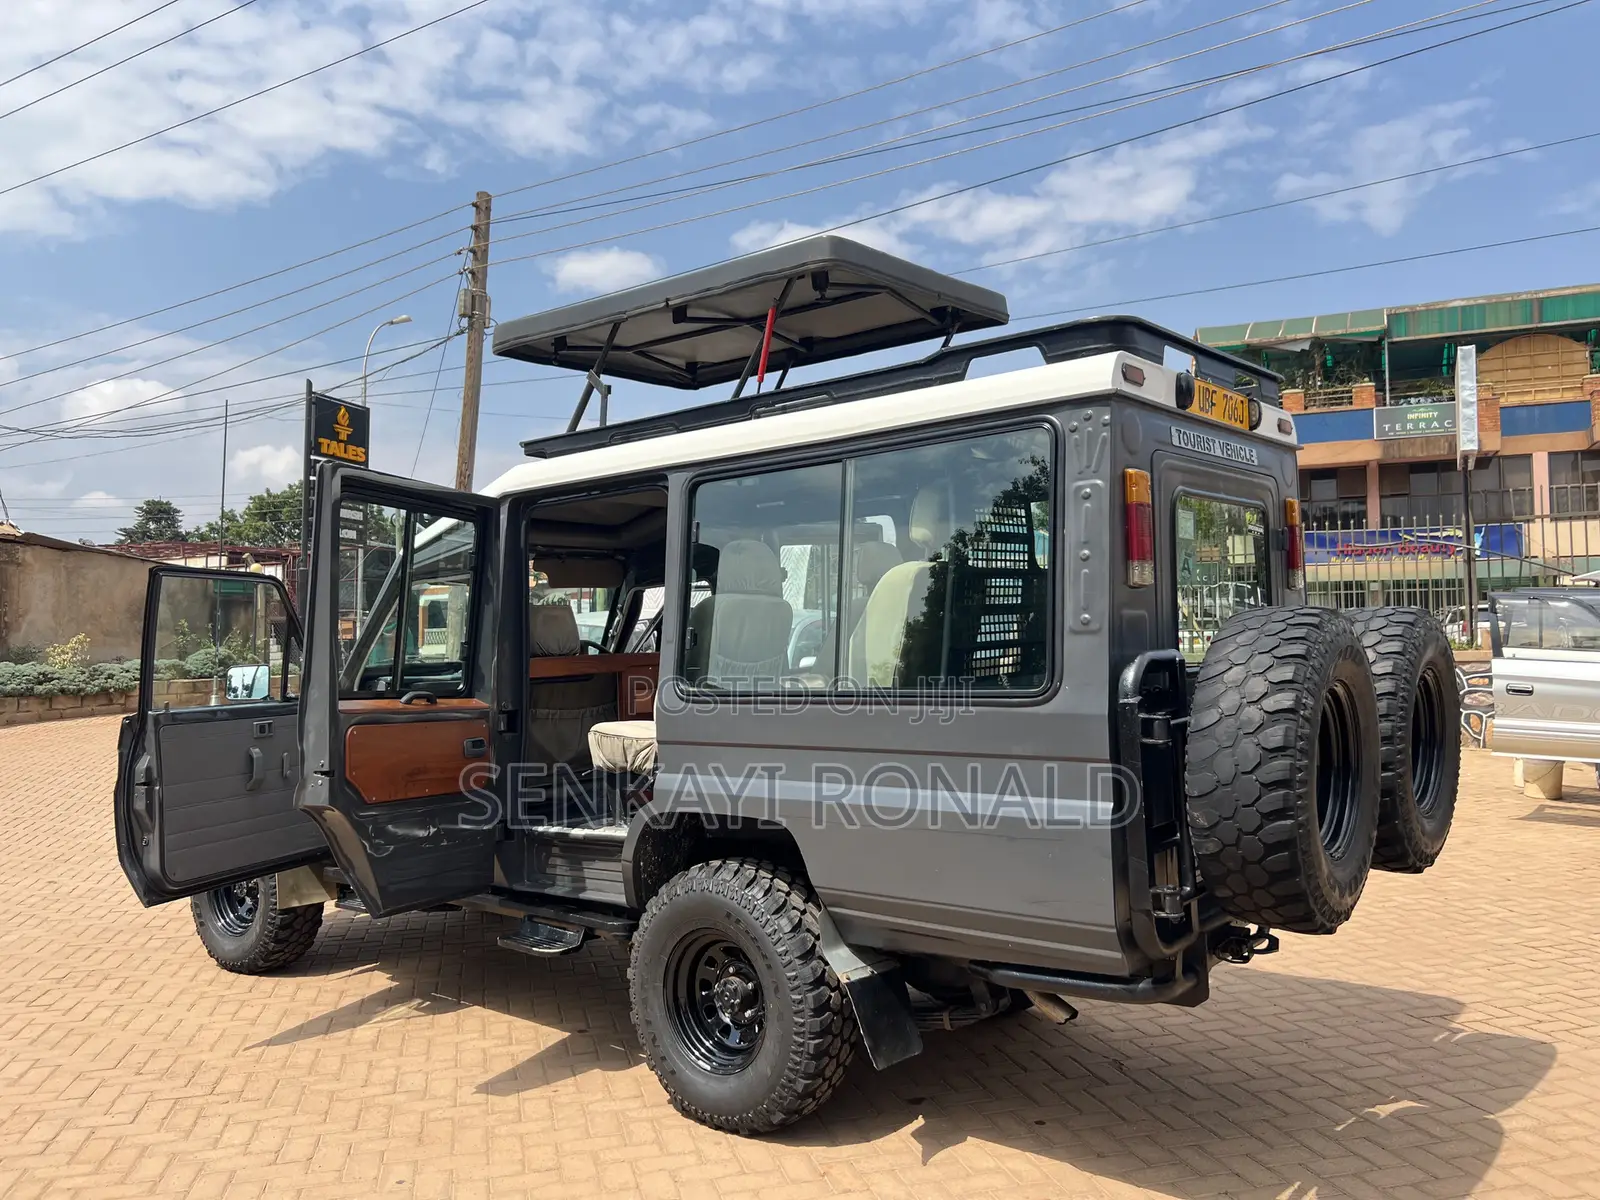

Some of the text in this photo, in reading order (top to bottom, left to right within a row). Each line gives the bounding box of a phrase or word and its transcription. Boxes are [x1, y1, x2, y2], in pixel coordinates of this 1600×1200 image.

[1198, 384, 1217, 416] UBF
[1383, 420, 1453, 431] TERRAC
[1407, 411, 1438, 420] INFINITY
[318, 437, 366, 462] TALES
[1175, 428, 1255, 463] TOURIST VEHICLE
